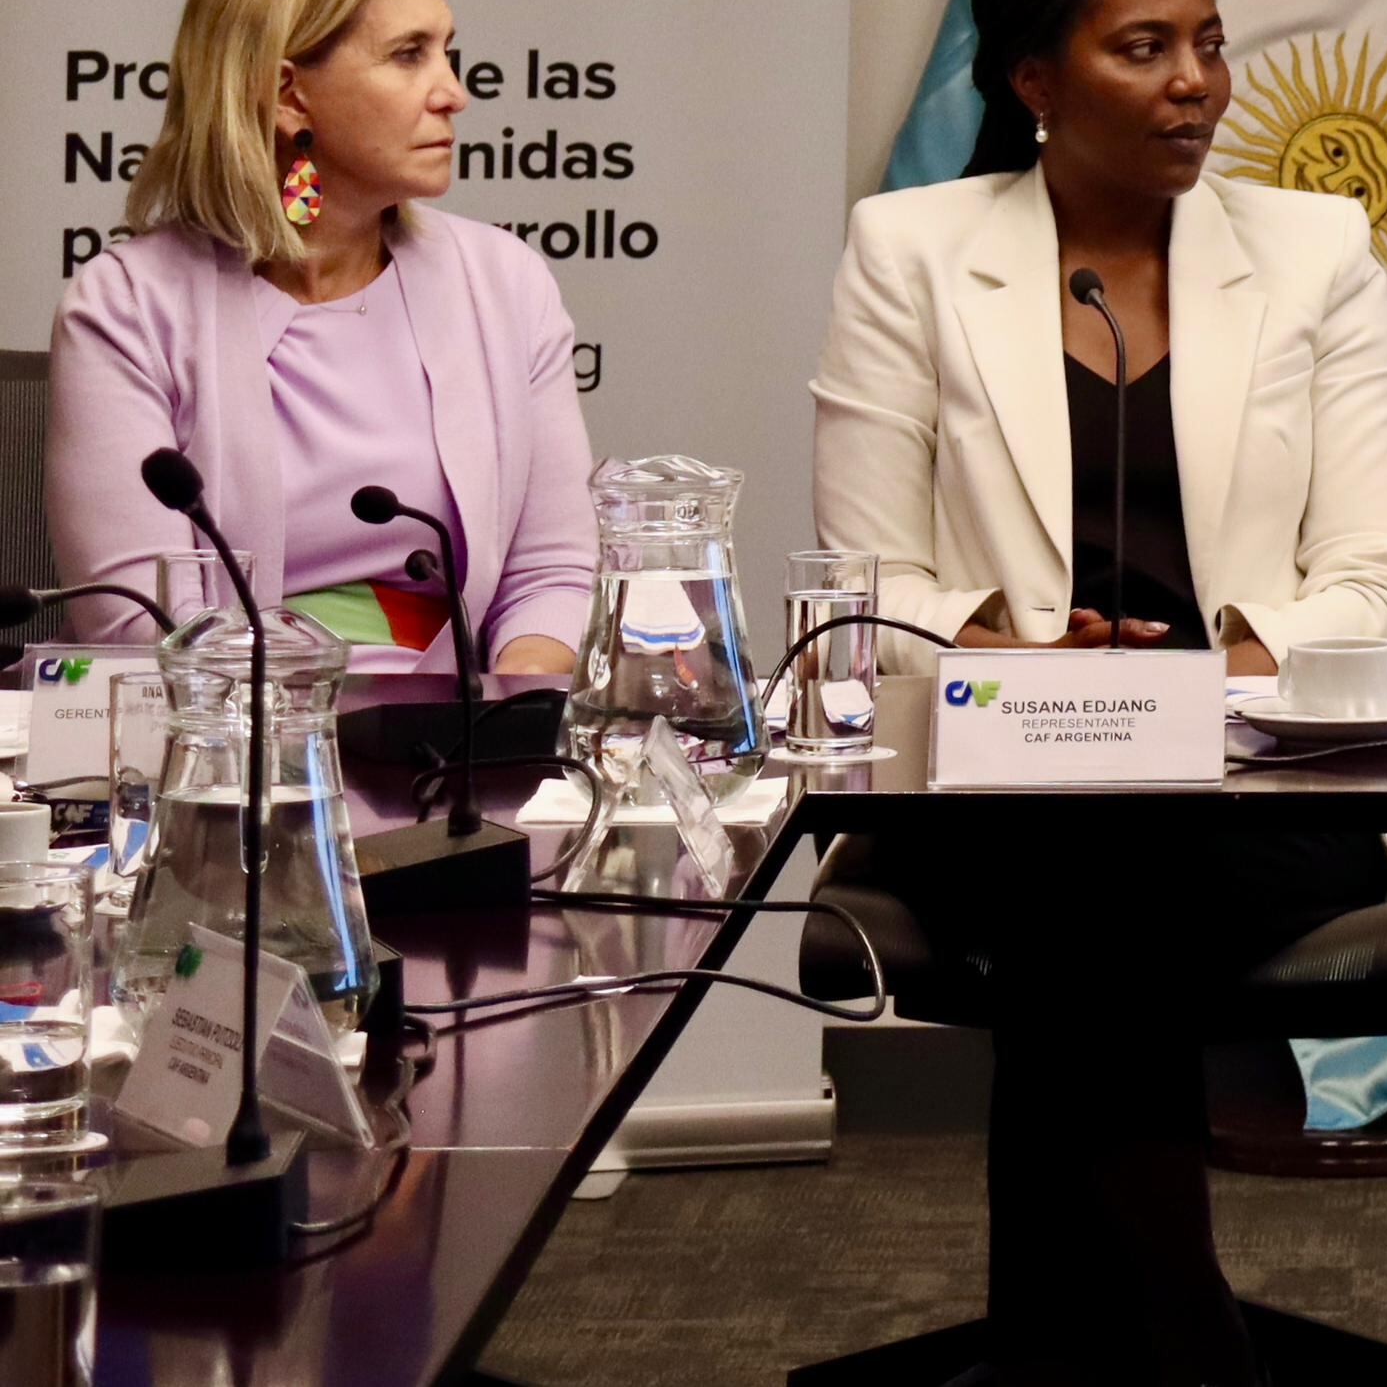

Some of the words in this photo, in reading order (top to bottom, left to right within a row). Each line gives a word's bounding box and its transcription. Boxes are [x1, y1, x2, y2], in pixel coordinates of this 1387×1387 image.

[527, 49, 616, 100] las
[458, 126, 634, 180] nidas
[38, 656, 93, 686] CAF
[945, 680, 1002, 707] CAF
[54, 708, 110, 720] GERENT
[1001, 701, 1077, 714] SUSANA
[1083, 699, 1157, 713] EDJANG
[1022, 718, 1135, 729] REPRESENTANTE
[1024, 733, 1051, 743] CAF
[1055, 732, 1132, 742] ARGENTINA
